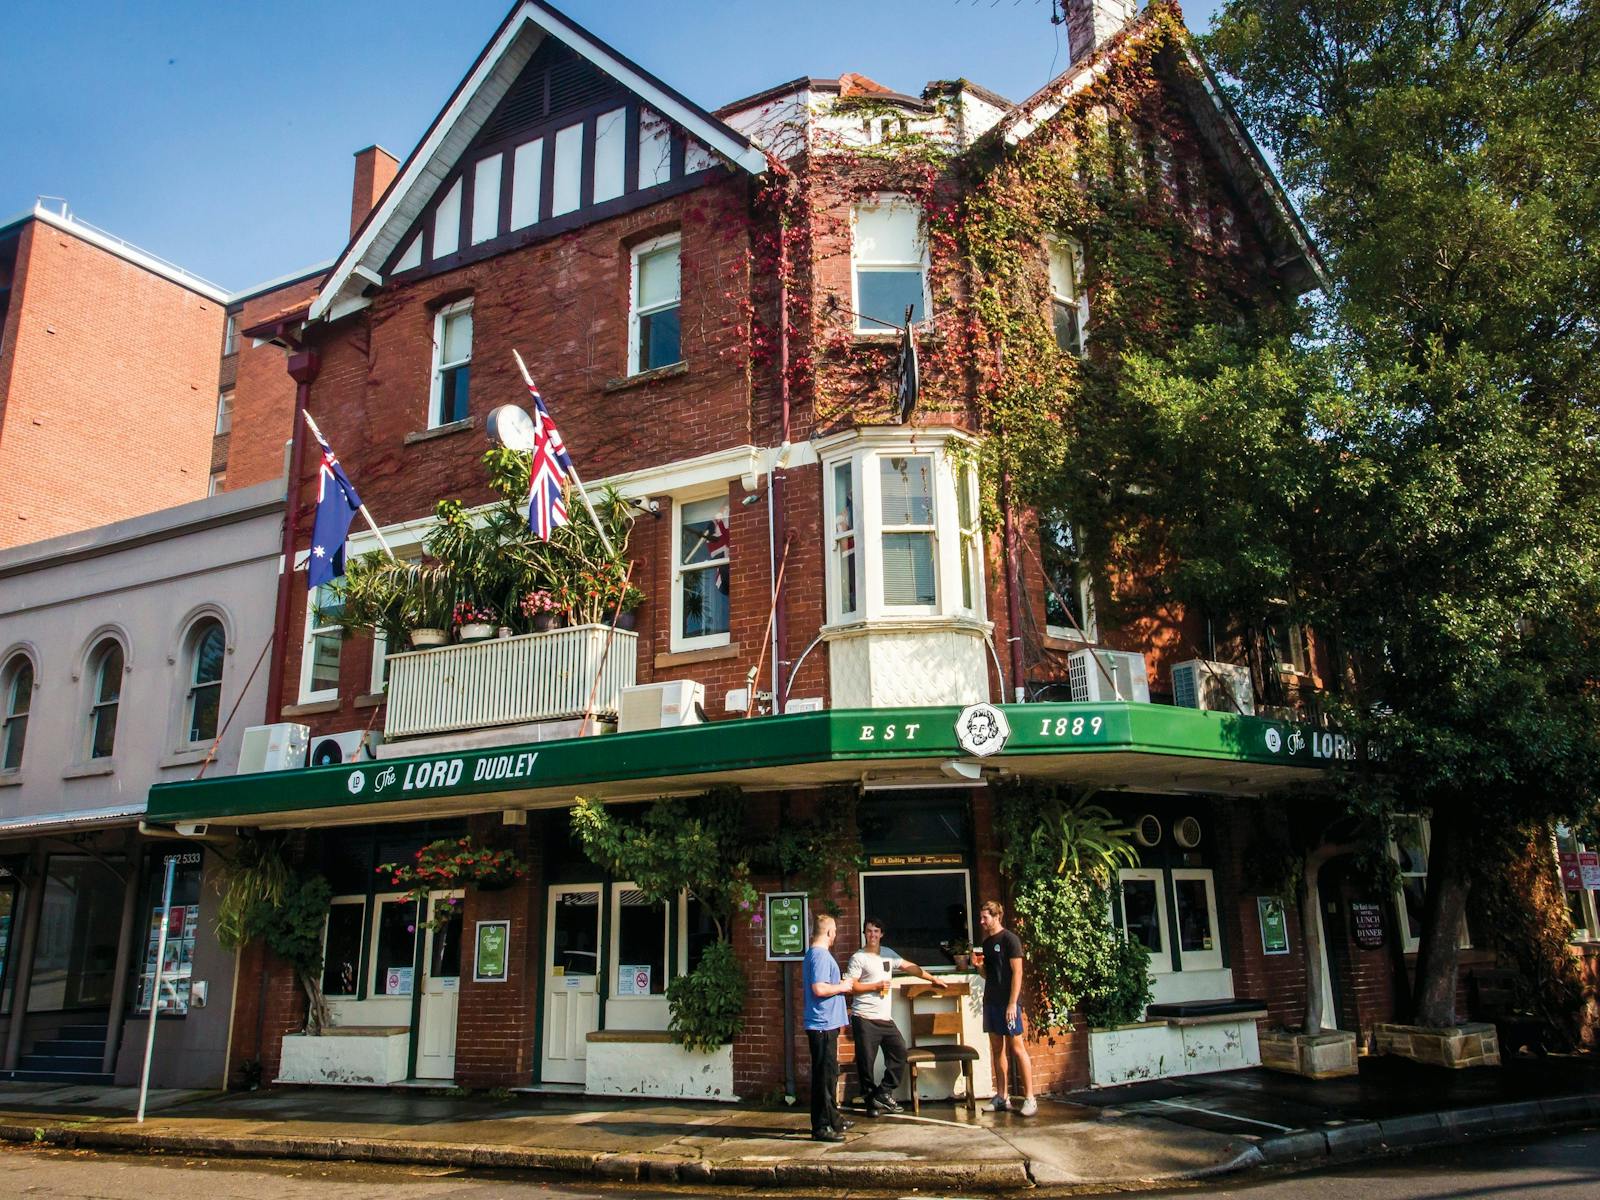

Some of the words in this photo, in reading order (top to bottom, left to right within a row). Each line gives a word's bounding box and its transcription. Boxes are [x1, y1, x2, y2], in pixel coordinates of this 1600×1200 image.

[859, 723, 920, 741] EST
[1039, 716, 1103, 736] 1889
[1287, 730, 1306, 756] The
[374, 766, 397, 793] The
[402, 758, 464, 791] LORD
[473, 752, 539, 782] DUDLEY
[182, 852, 201, 864] 5333
[1356, 915, 1380, 924] LUNCH
[1357, 928, 1383, 937] DINNER
